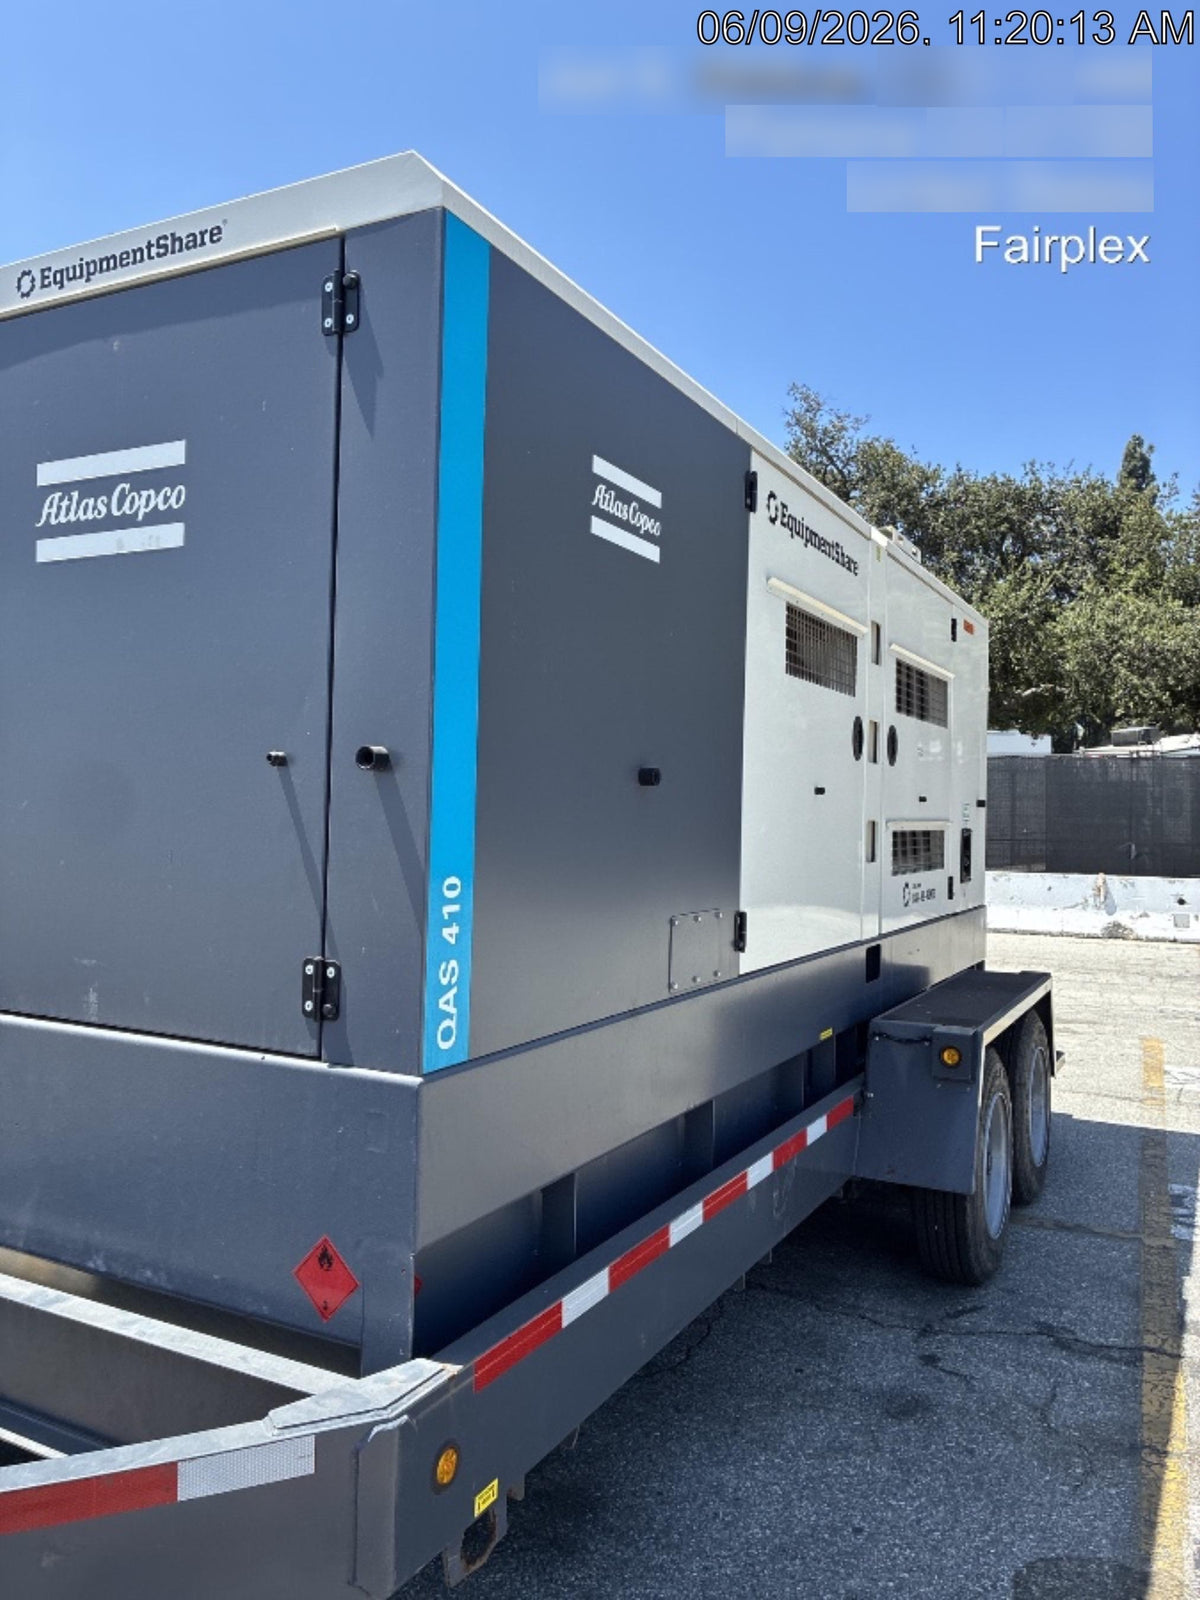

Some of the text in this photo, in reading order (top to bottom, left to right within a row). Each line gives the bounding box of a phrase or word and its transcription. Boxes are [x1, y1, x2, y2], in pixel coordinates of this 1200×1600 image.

[35, 483, 186, 527] Atlas Copco
[592, 483, 661, 536] Atlas Copco
[780, 501, 858, 577] EquipmentShare
[437, 876, 461, 1050] QAS 410
